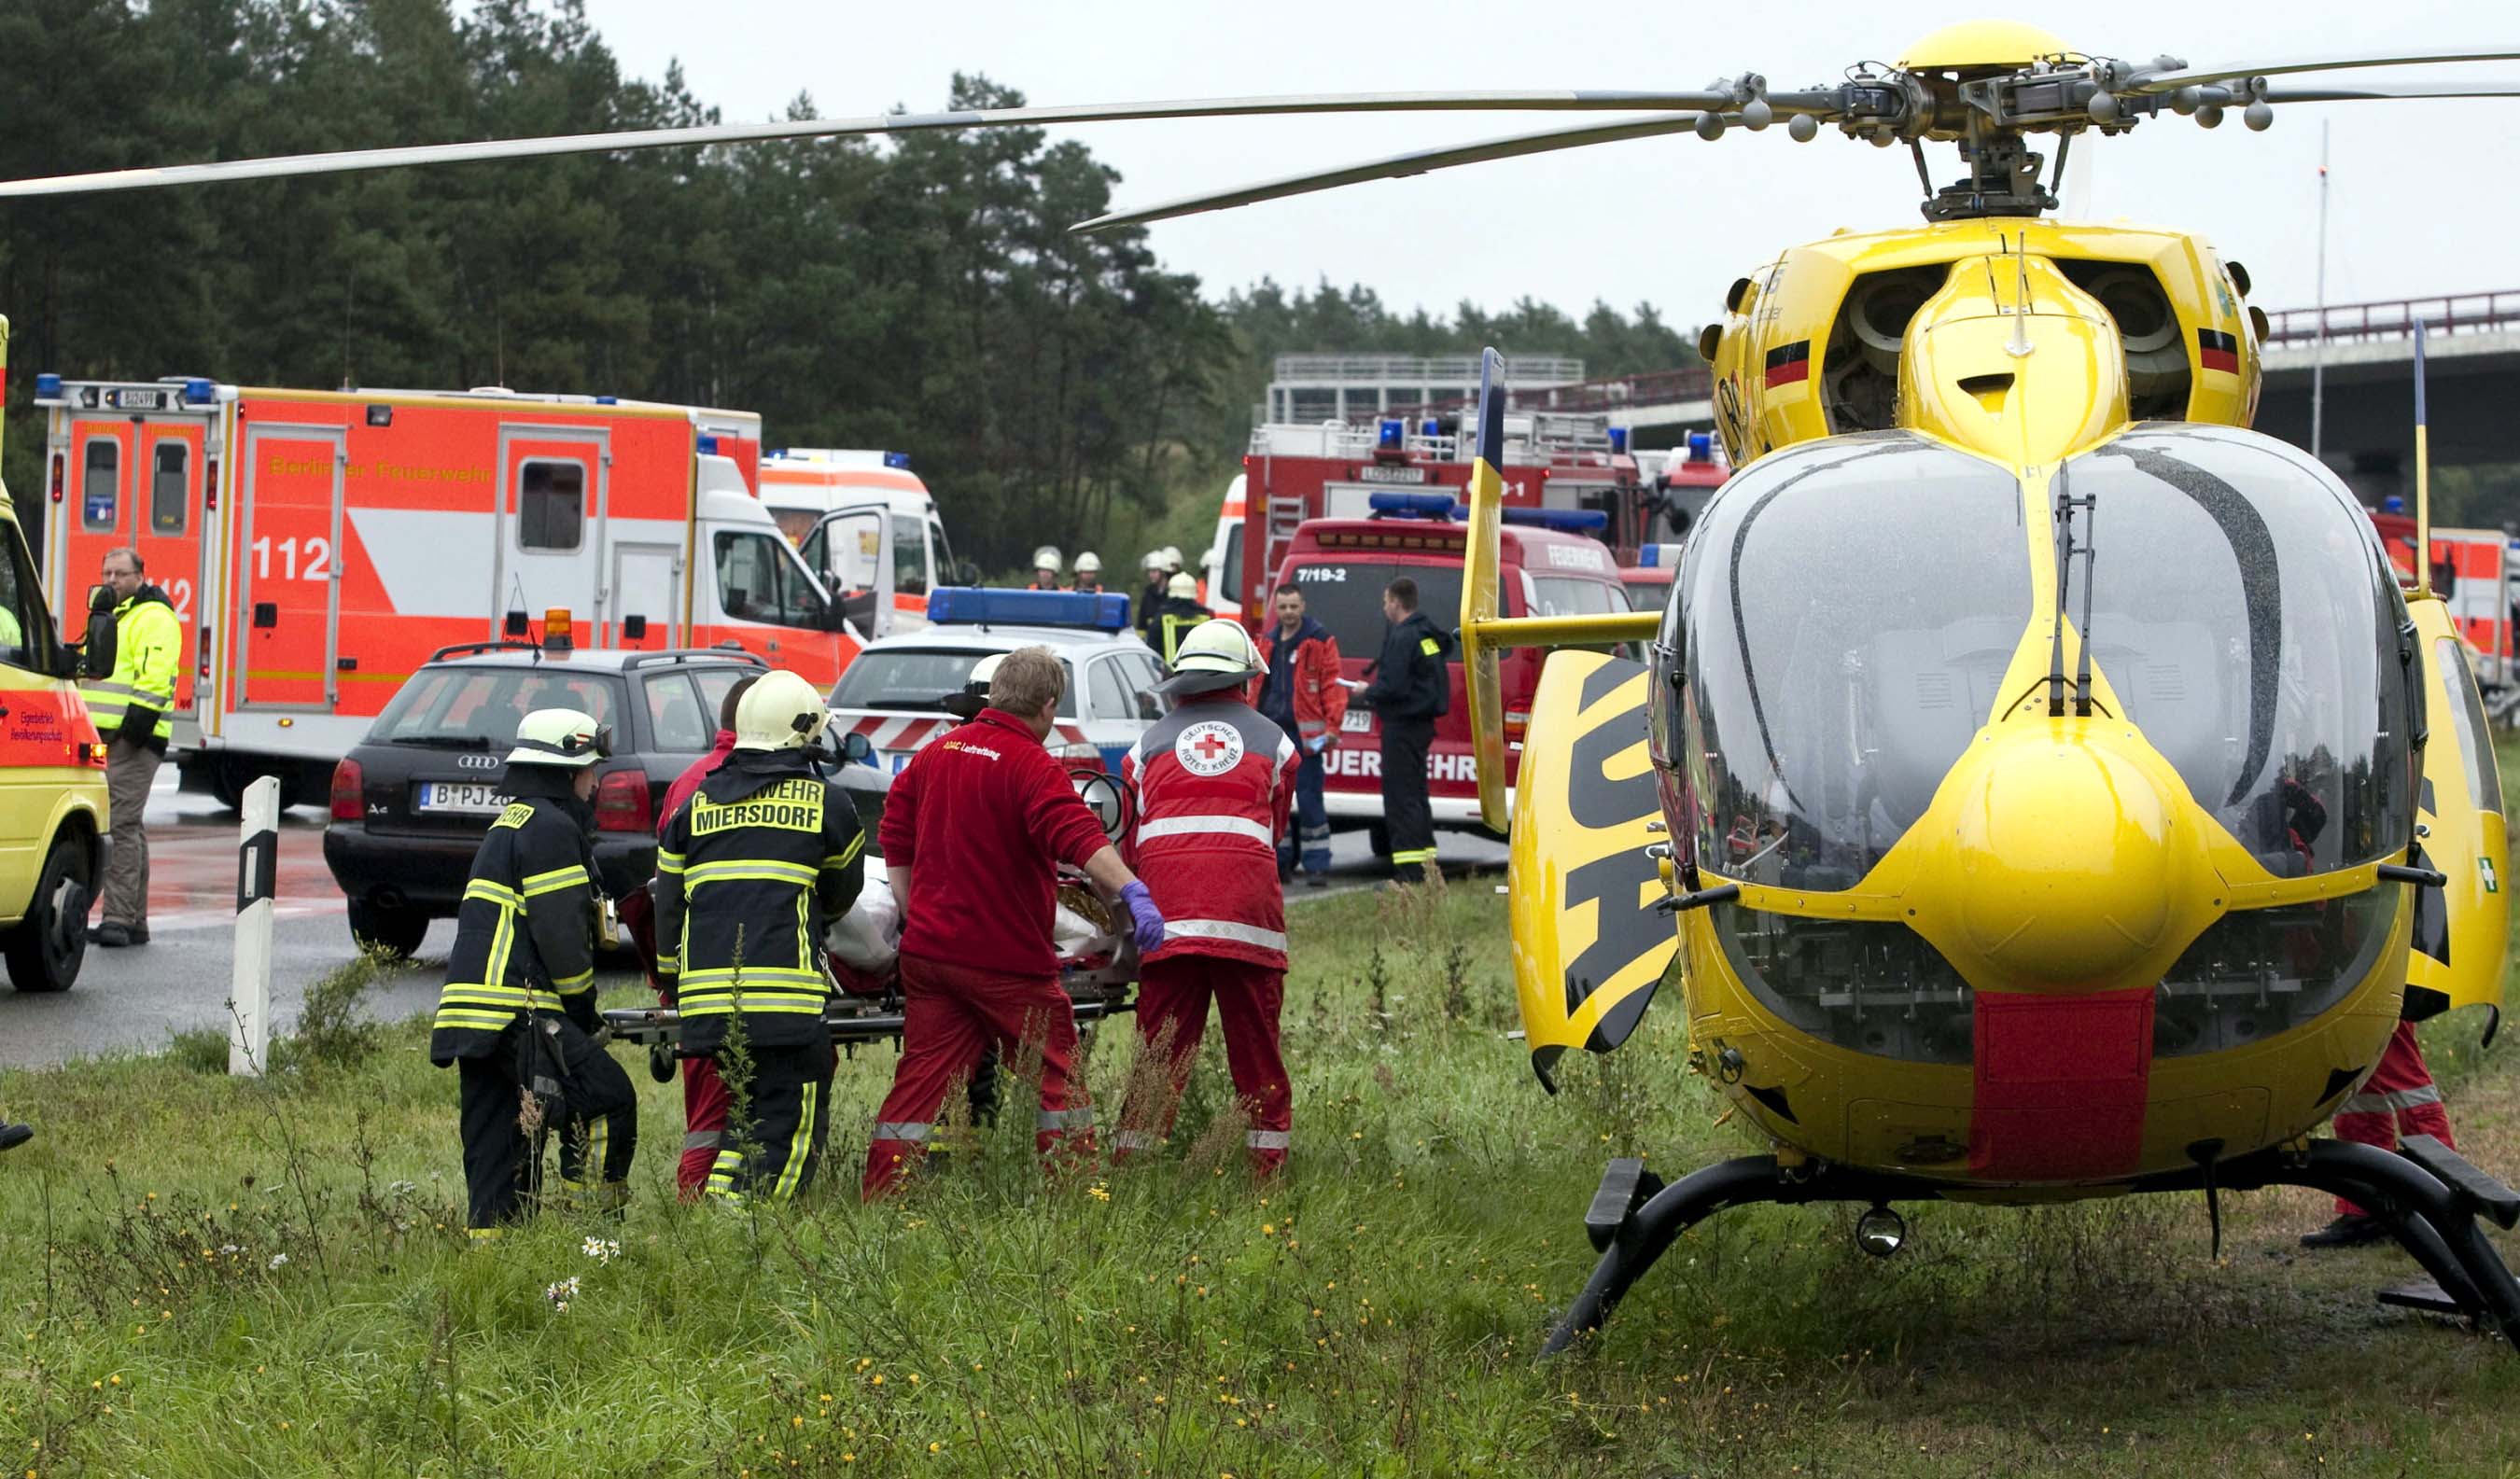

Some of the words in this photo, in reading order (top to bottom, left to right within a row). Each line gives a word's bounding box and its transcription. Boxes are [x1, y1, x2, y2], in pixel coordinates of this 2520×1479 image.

[269, 456, 366, 478] Berliner
[375, 462, 492, 483] Feuerwehr
[252, 537, 330, 580] 112
[1297, 567, 1346, 582] 7/19-2
[1183, 724, 1238, 743] DEUTSCHES
[960, 742, 1001, 761] Luftrettung
[1181, 748, 1207, 772] ROTES
[1211, 747, 1239, 771] KREUZ
[437, 786, 449, 804] B
[461, 787, 484, 805] PJ
[696, 804, 819, 832] MIERSDORF
